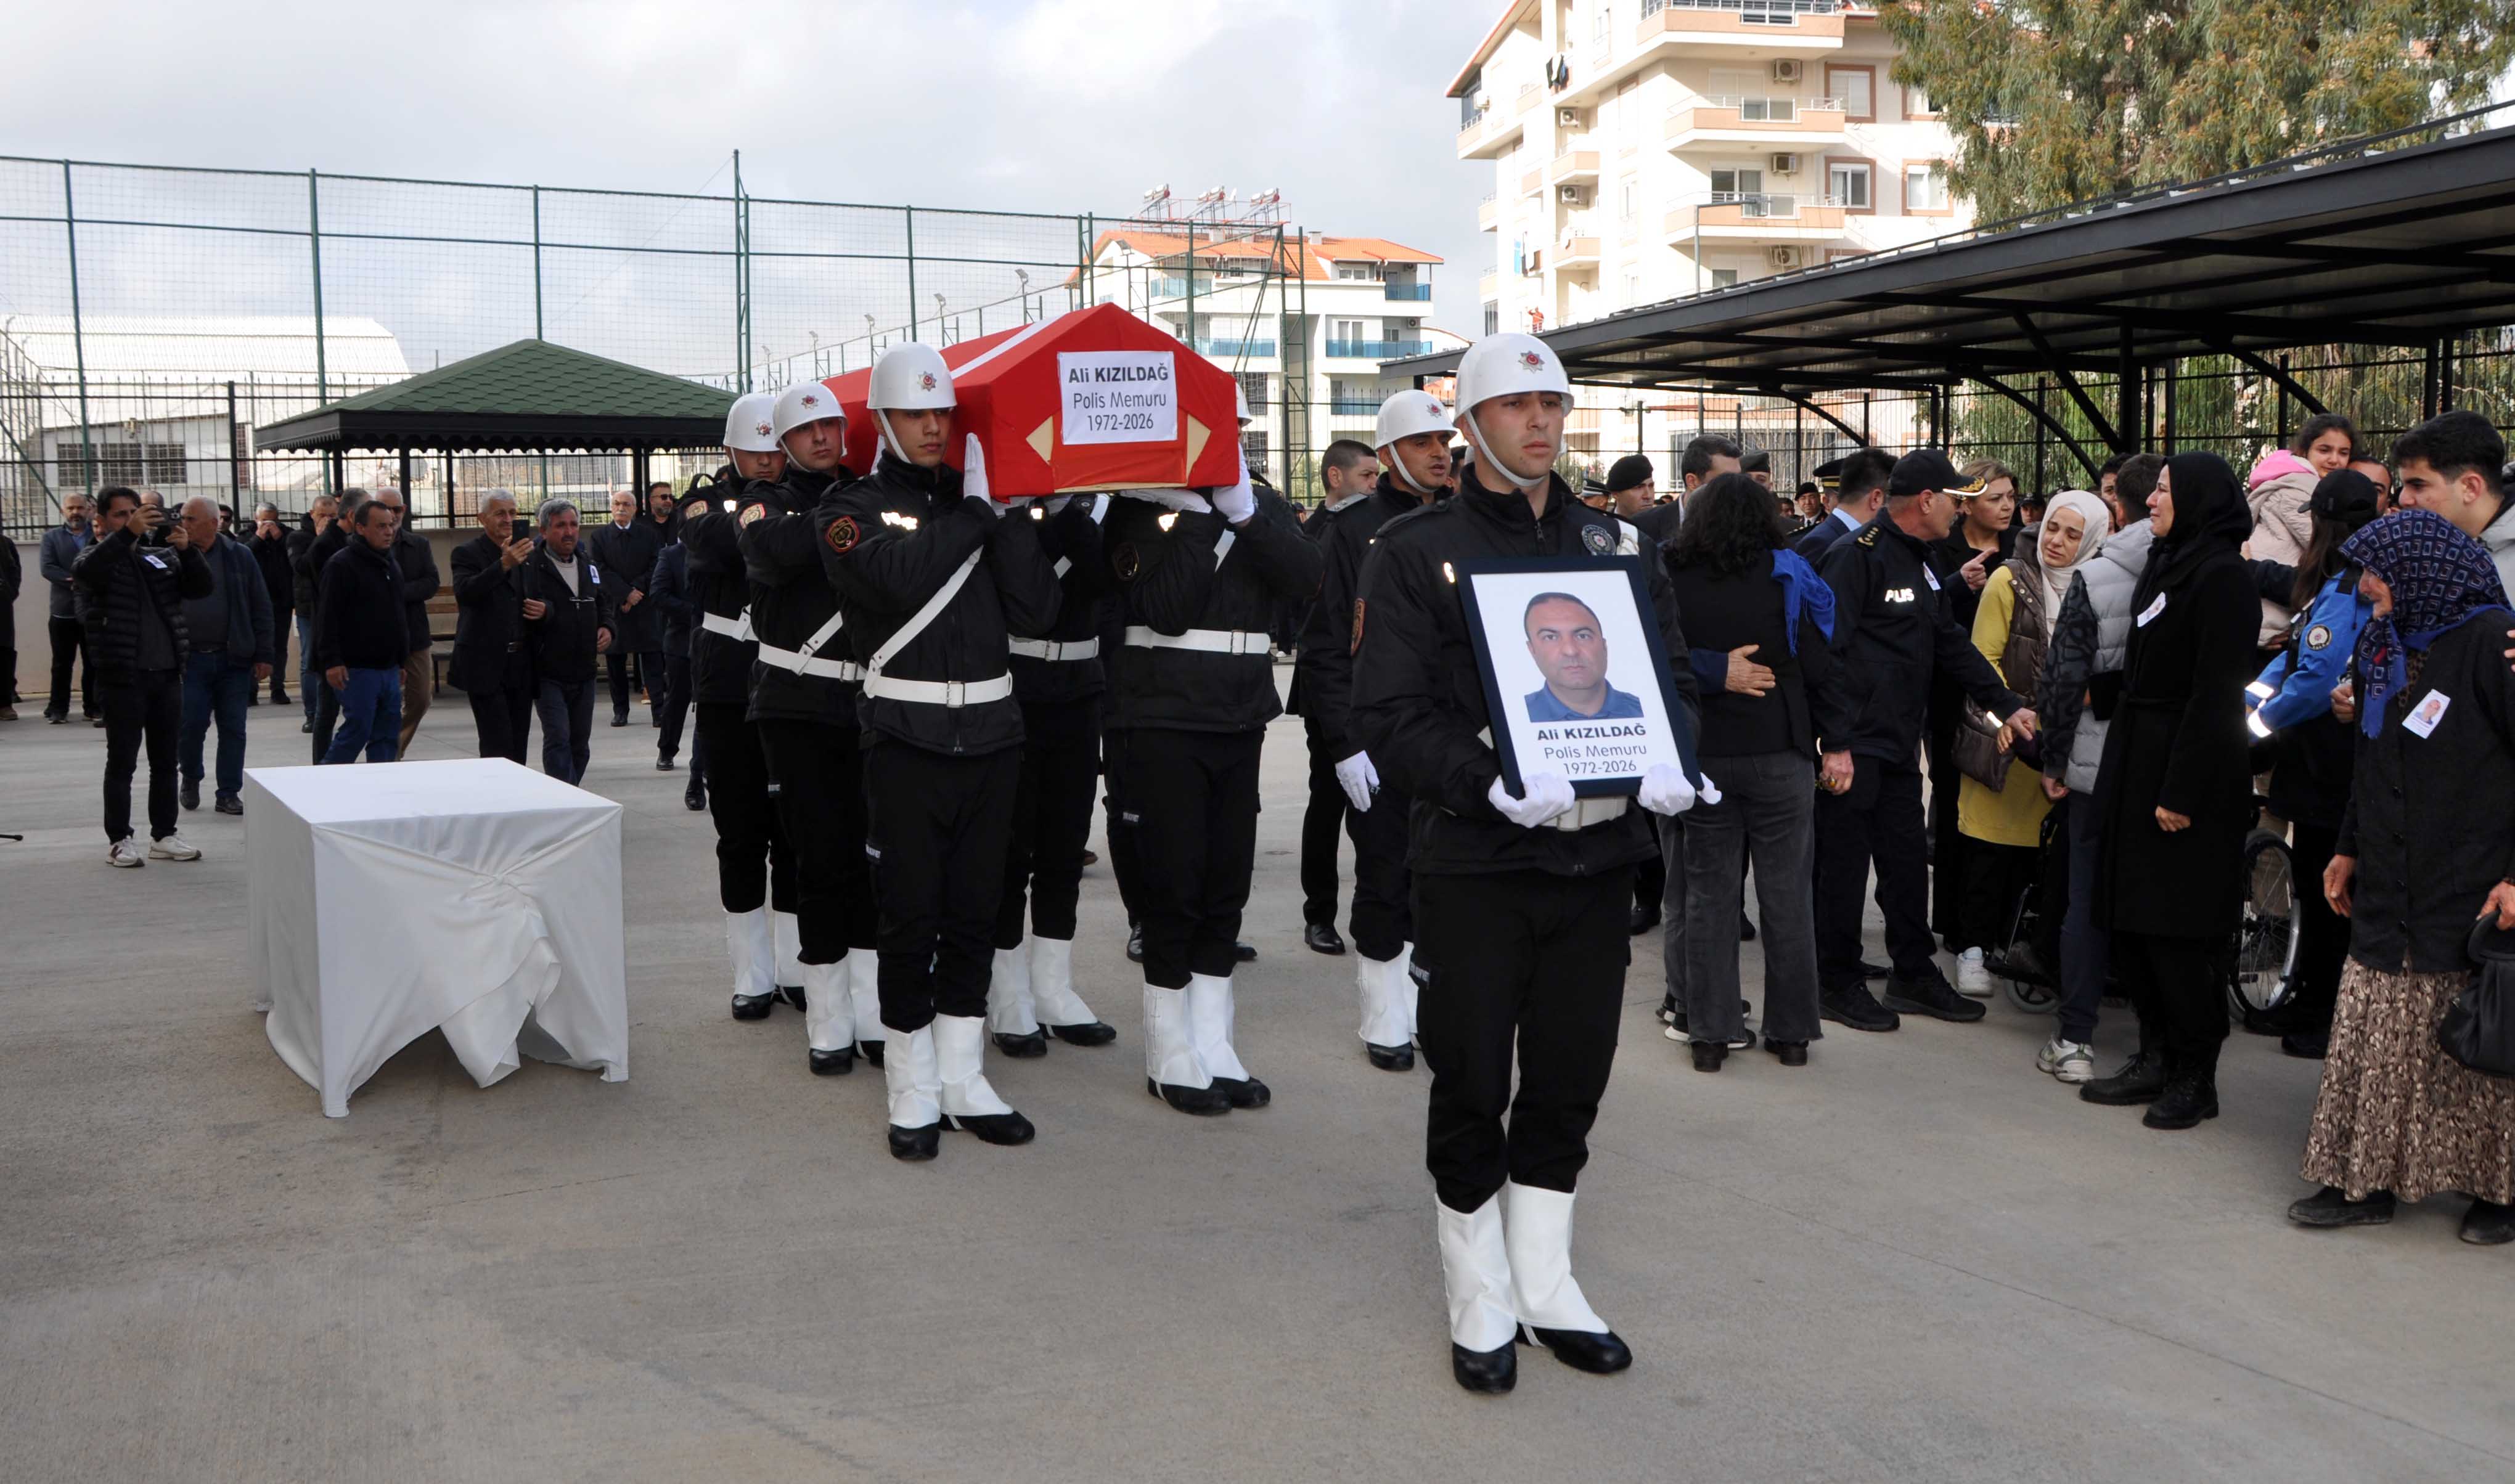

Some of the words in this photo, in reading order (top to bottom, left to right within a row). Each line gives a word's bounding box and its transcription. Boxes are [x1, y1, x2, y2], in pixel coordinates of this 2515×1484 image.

[1068, 368, 1089, 383] Ali
[1095, 363, 1169, 382] KIZILDAĞ
[1073, 393, 1106, 409] Polis
[1110, 391, 1166, 408] Memuru
[1087, 413, 1154, 431] 1972-2026
[1537, 729, 1559, 741] Ali
[1564, 723, 1646, 740] KIZILDAĞ
[1544, 746, 1581, 759] Polis
[1586, 744, 1647, 757] Memuru
[1563, 760, 1637, 775] 1972-2026
